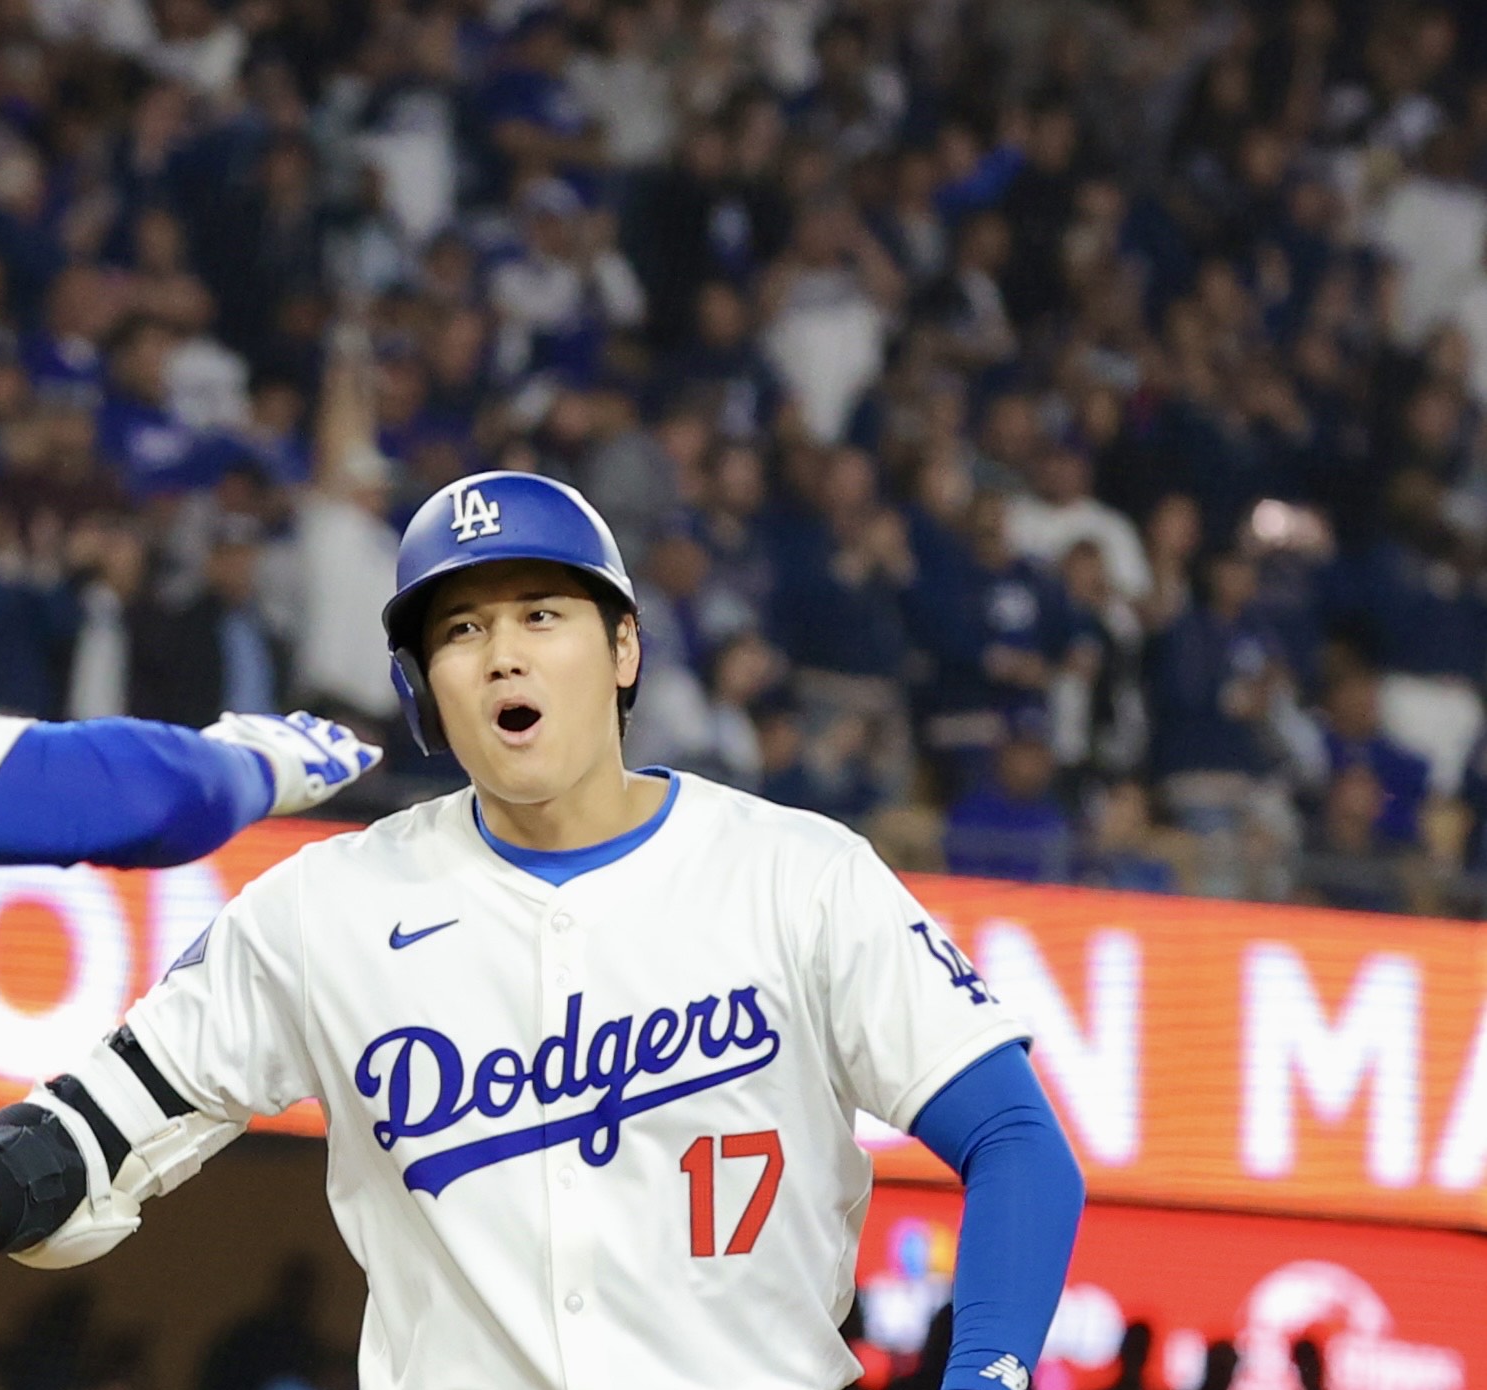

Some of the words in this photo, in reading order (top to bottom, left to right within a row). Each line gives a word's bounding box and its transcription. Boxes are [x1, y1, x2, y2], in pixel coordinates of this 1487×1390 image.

[450, 484, 501, 543] LA
[355, 985, 780, 1199] Dodgers
[679, 1129, 785, 1257] 17
